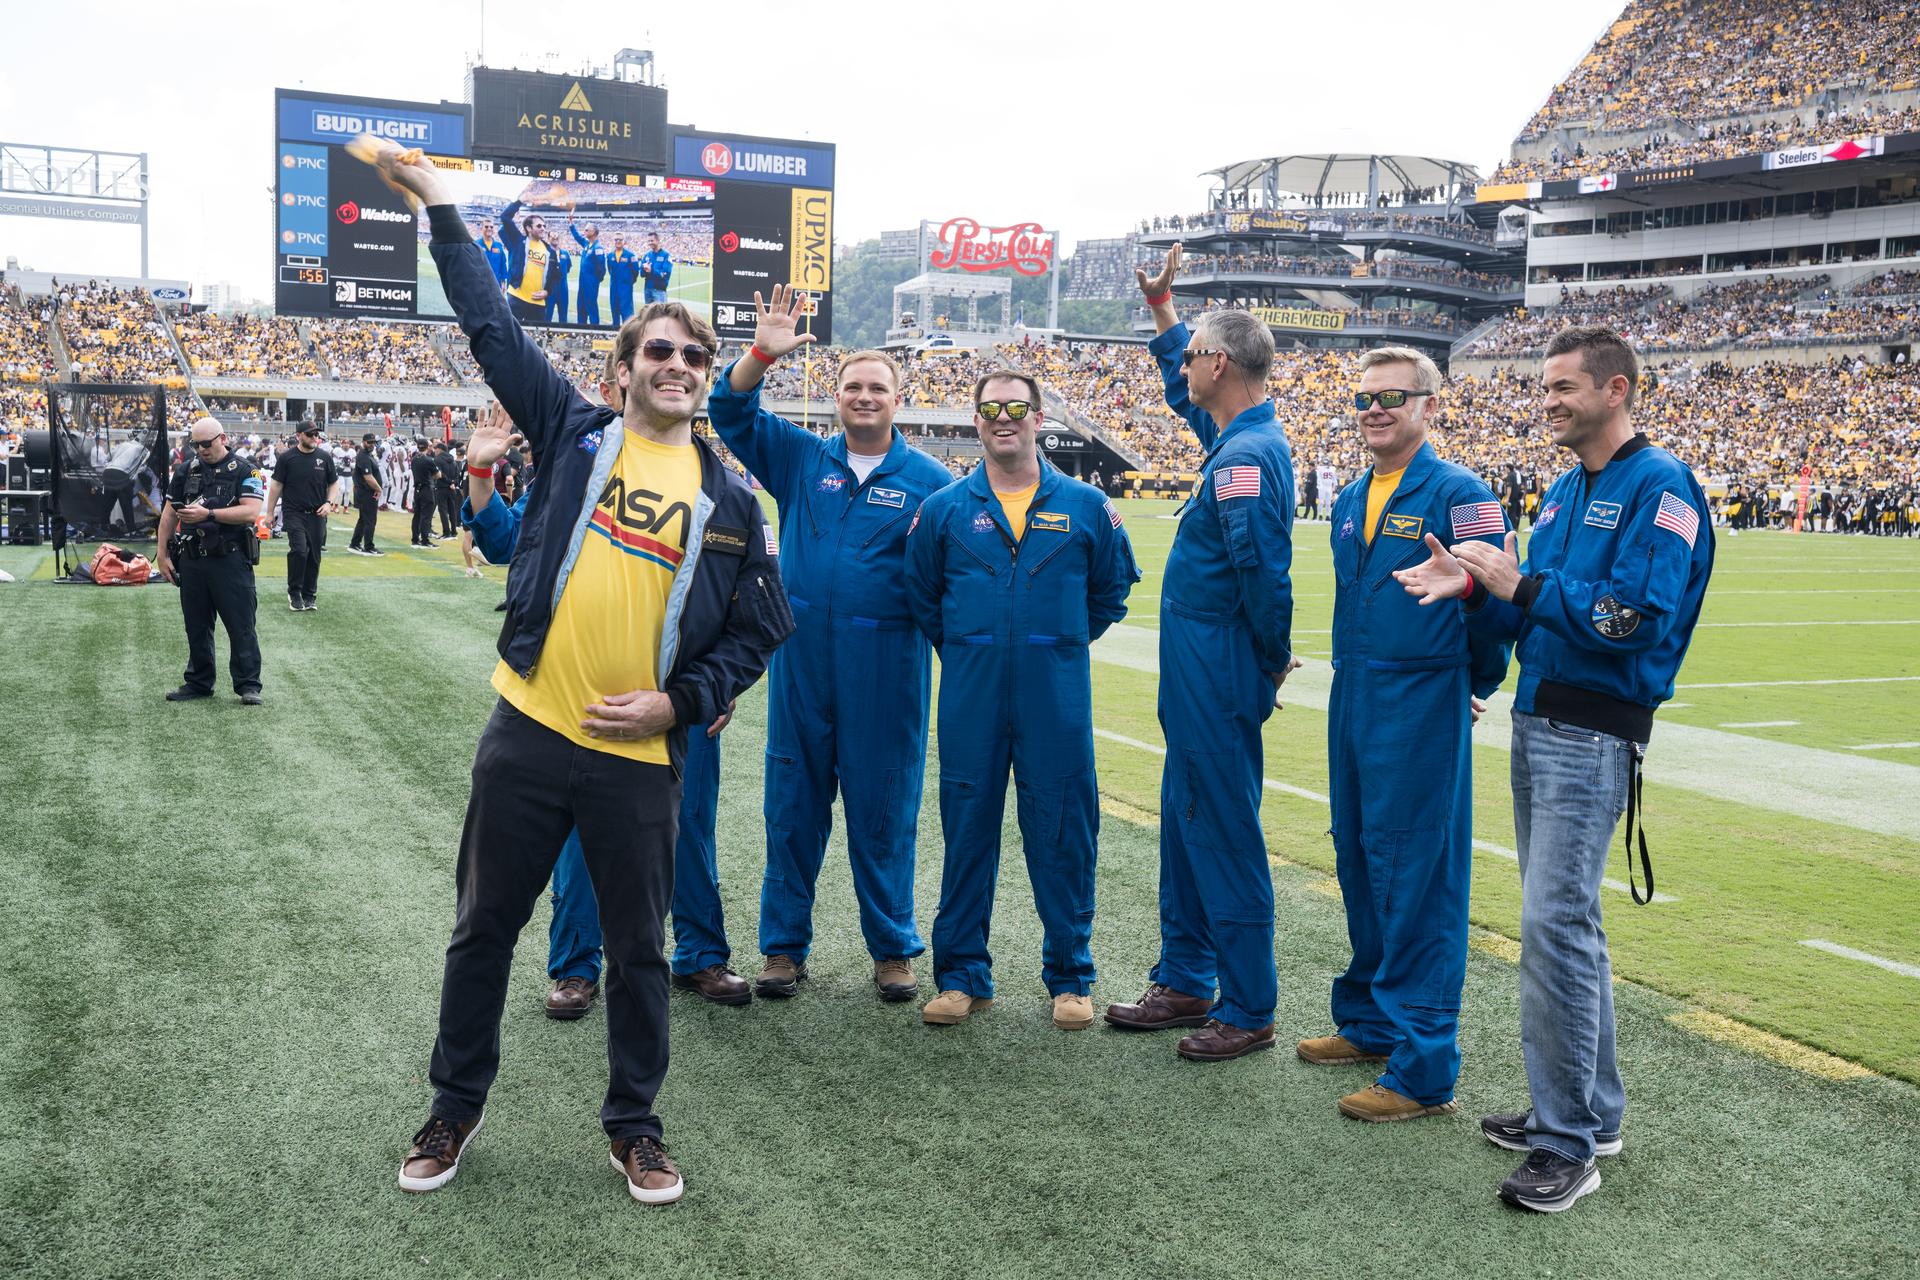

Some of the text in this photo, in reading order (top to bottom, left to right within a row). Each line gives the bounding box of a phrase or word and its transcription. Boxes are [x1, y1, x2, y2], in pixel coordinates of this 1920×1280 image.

[316, 114, 428, 140] BUD LIGHT
[517, 112, 632, 138] ACRISURE
[540, 133, 609, 151] STADIUM
[297, 157, 326, 170] PNC
[428, 157, 462, 170] teelers
[704, 149, 807, 176] 84 LUMBER
[1778, 150, 1818, 165] Steelers
[479, 163, 489, 171] 13
[499, 164, 517, 174] 3RD
[523, 166, 529, 175] 5
[550, 169, 562, 178] 49
[8, 162, 150, 201] EOPLES
[578, 172, 597, 181] 2ND
[600, 174, 619, 183] 1:56
[670, 183, 712, 192] FALCONS
[297, 194, 326, 208] PNC
[0, 203, 139, 223] ssential Utilities Company
[360, 207, 412, 223] Wabtec
[297, 232, 326, 245] PNC
[739, 236, 784, 252] Wabtec
[804, 196, 827, 285] UPMC
[353, 243, 395, 251] WABTEC.COM
[299, 269, 324, 283] 1:56
[733, 269, 769, 278] WABTEC.COM
[158, 288, 180, 299] Ford
[357, 287, 412, 301] BETMGM
[1255, 309, 1340, 329] #HEREWEGO
[974, 518, 993, 526] NAS
